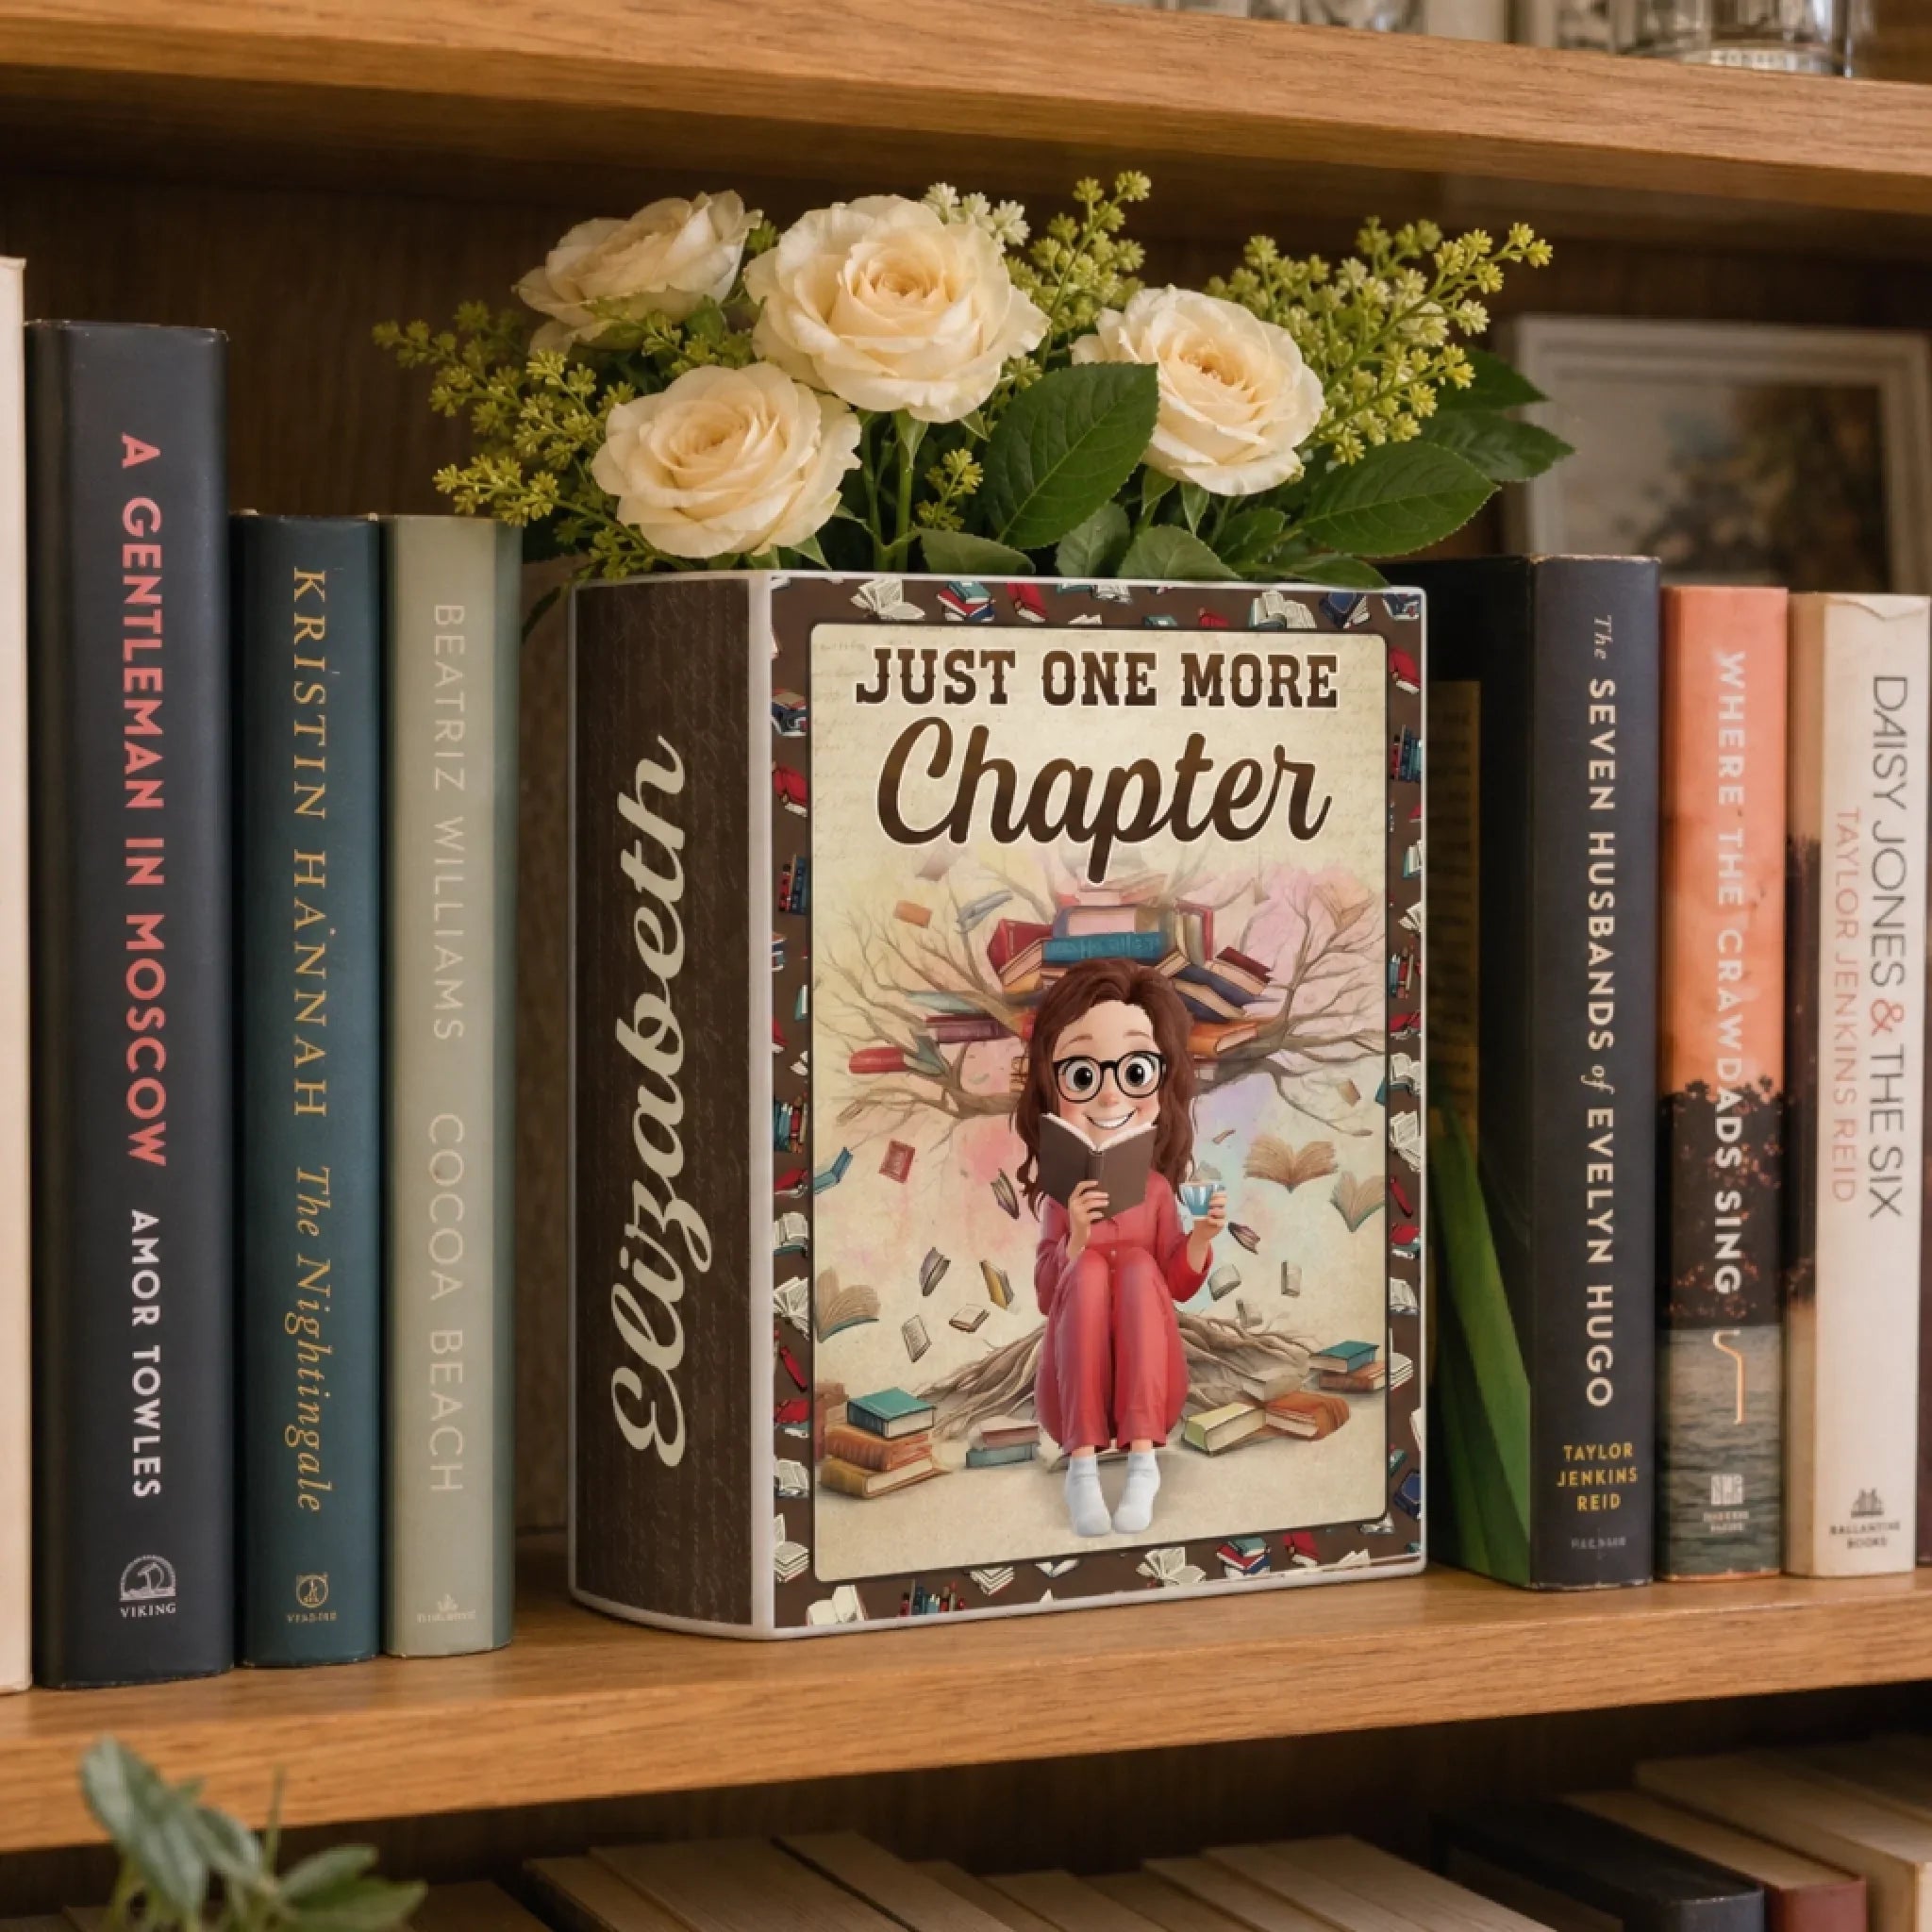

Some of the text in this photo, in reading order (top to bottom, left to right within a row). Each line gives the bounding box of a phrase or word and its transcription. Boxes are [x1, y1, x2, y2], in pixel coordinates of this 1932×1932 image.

[121, 434, 167, 1167] A GENTLEMAN IN MOSCOW
[293, 567, 327, 1117] KRISTIN HANNAH
[434, 604, 466, 1041] BEATRIZ WILLIAMS
[856, 647, 1339, 708] JUST ONE MORE
[876, 715, 1331, 884] Chapter
[610, 735, 713, 1467] Elizabeth
[1580, 614, 1616, 1407] The SEVEN HUSBANDS of EVELYN HUGO
[1714, 651, 1746, 1295] WHERE THE CRAWDADS SING
[1831, 807, 1860, 1203] TAYLOR JENKINS REID
[1869, 675, 1908, 1219] DAISY JONES & THE SIX
[130, 1209, 160, 1498] AMOR TOWLES
[284, 1166, 334, 1512] The Nightingale
[428, 1113, 465, 1494] COCOA BEACH
[1557, 1466, 1638, 1487] JENKINS
[1563, 1442, 1633, 1461] TAYLOR
[120, 1603, 176, 1617] VIKING
[1577, 1492, 1621, 1511] REID
